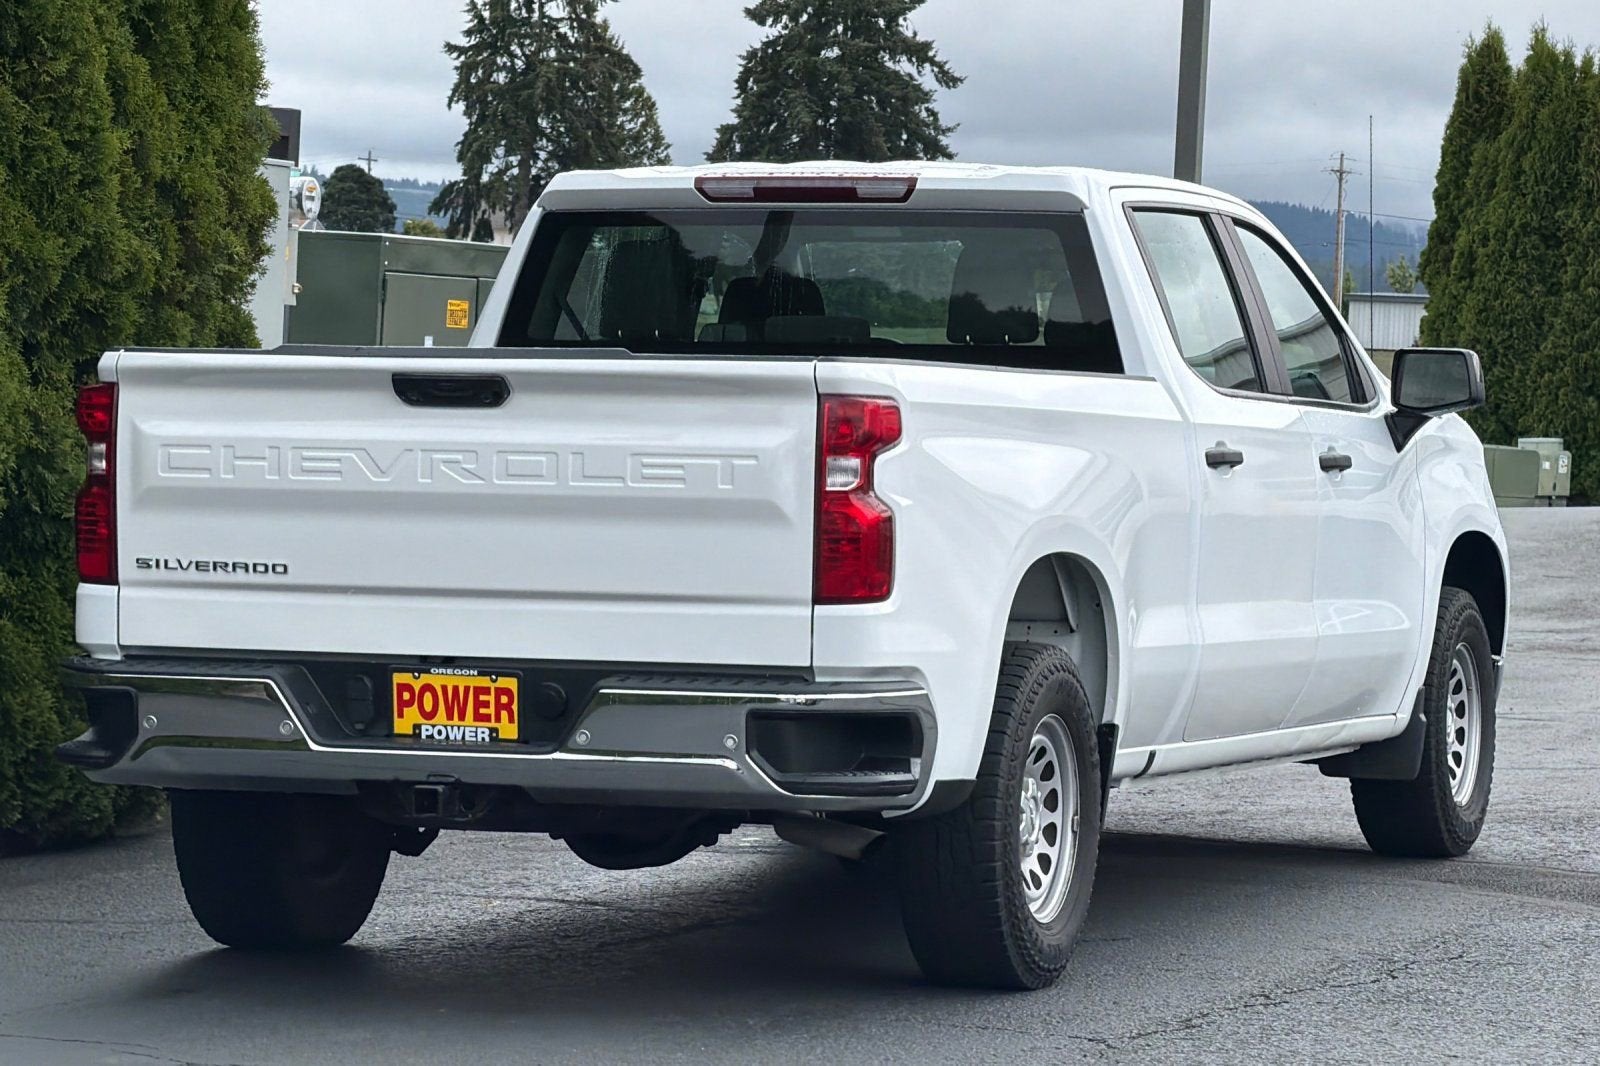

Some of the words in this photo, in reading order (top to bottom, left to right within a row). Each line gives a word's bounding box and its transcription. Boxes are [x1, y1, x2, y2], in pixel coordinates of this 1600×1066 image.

[157, 444, 759, 489] CHEVROLET
[136, 557, 289, 575] SILVERADO
[430, 667, 478, 676] OREGON
[396, 682, 516, 724] POWER
[421, 725, 490, 742] POWER
